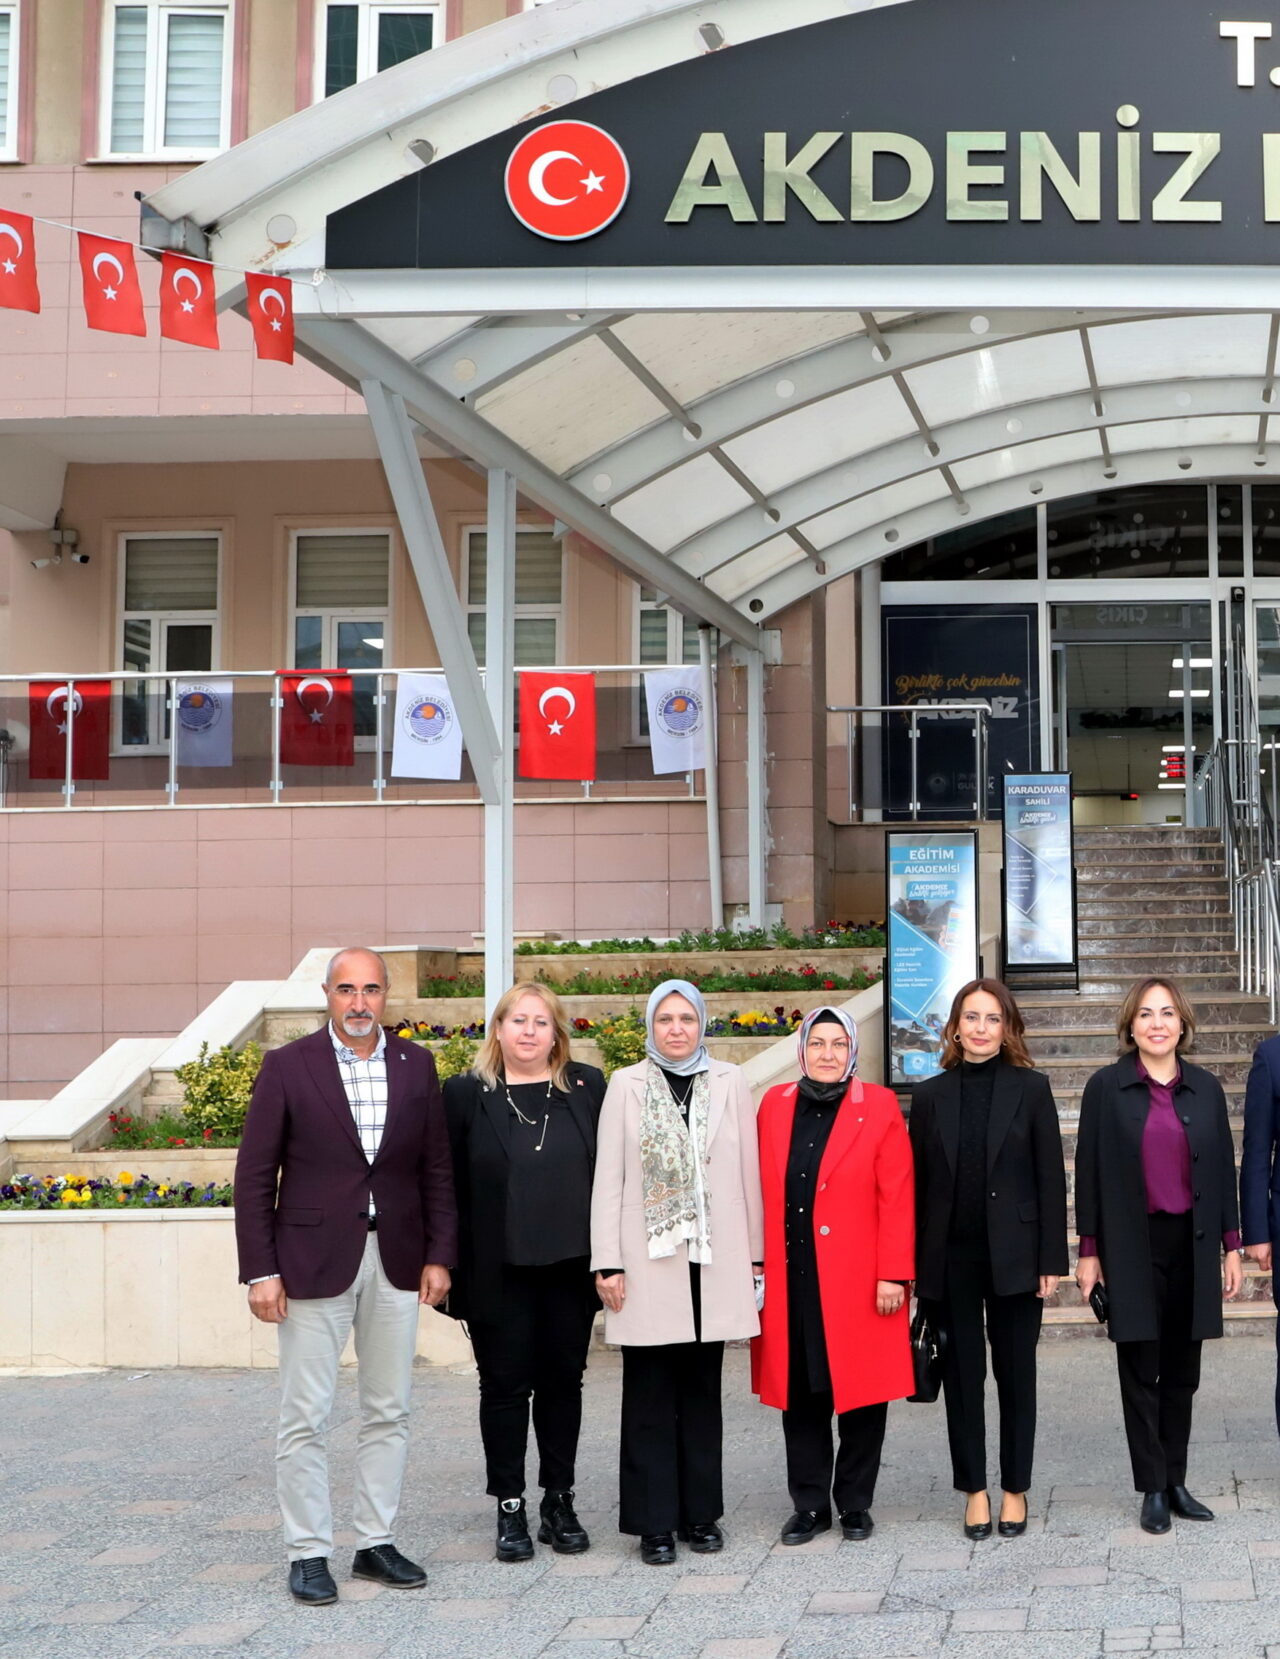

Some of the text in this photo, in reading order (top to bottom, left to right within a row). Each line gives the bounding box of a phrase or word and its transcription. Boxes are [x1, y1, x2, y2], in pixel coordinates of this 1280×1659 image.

[664, 103, 1223, 224] AKDENİZ
[895, 672, 1022, 695] Birlikte çok güzelsin
[1008, 784, 1067, 795] KARADUVAR
[1025, 797, 1050, 806] SAHİLİ
[909, 846, 954, 861] EĞİTİM
[904, 863, 960, 874] AKADEMİSİ
